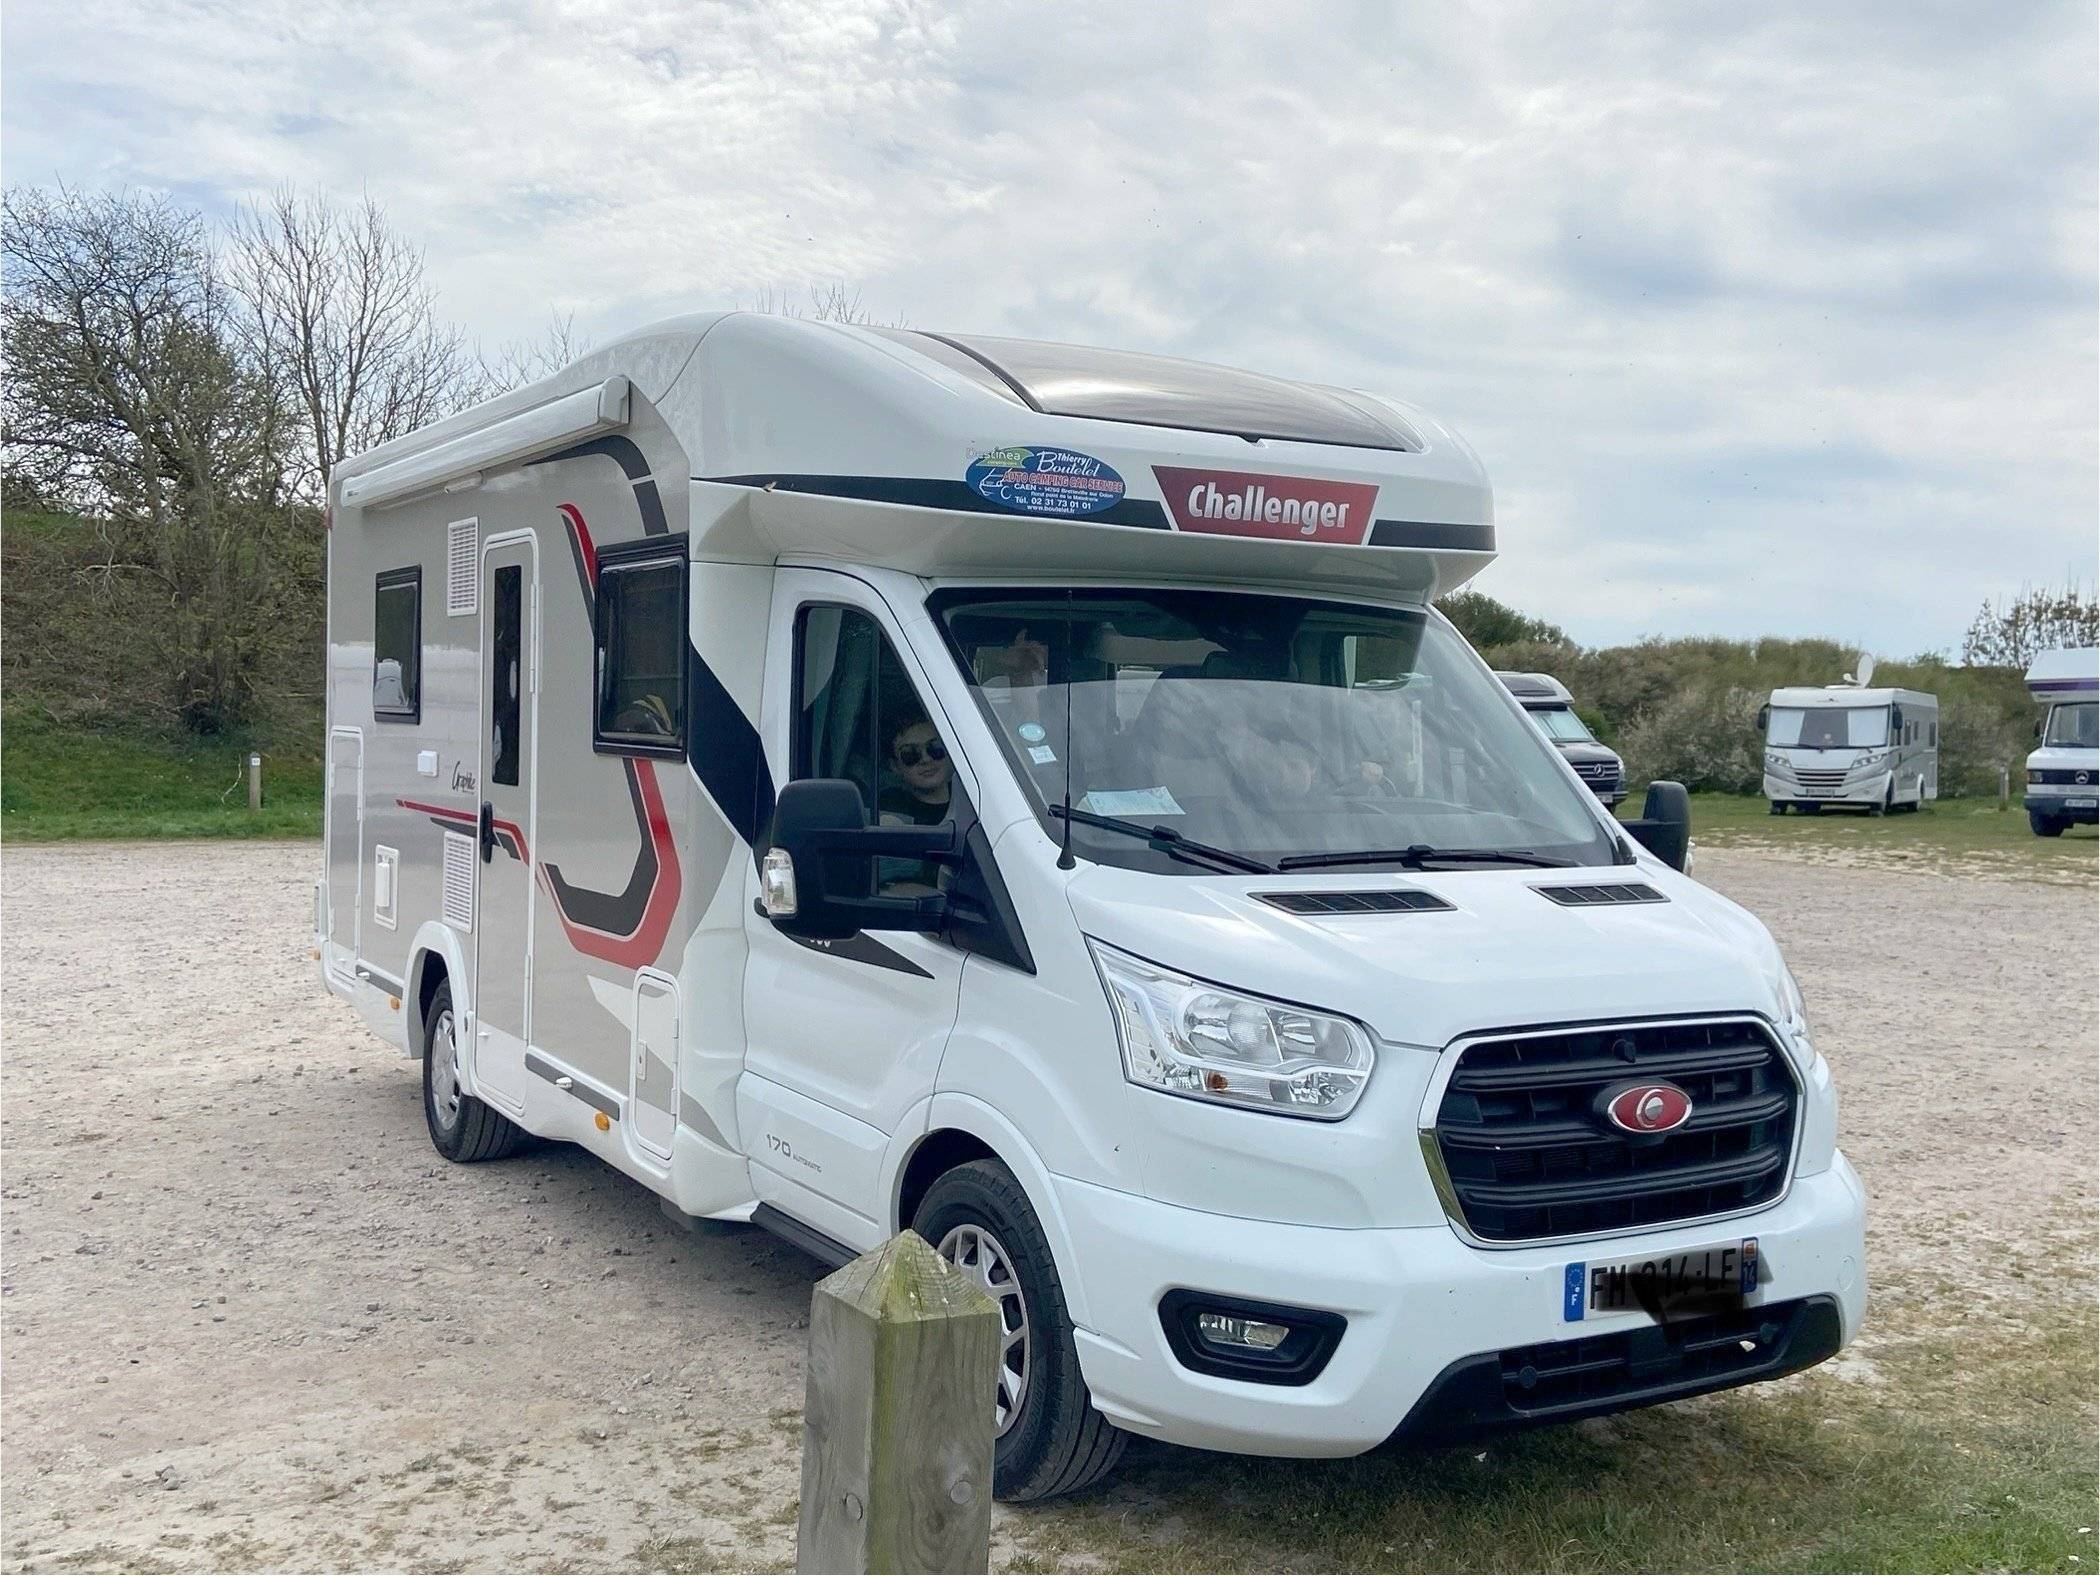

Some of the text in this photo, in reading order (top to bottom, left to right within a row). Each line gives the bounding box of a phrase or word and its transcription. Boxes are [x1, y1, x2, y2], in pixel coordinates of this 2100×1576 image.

[1036, 451, 1100, 476] Boutelet
[1057, 453, 1086, 466] Thierry
[1004, 471, 1123, 493] AUTO CAMPING CAR SERVICE
[1014, 483, 1037, 491] CAEN
[1031, 497, 1042, 505] 02
[1044, 498, 1055, 506] 31
[1057, 499, 1067, 507] 73
[1188, 482, 1350, 535] Challenger
[766, 1134, 791, 1157] 170
[1743, 1266, 1755, 1285] 14
